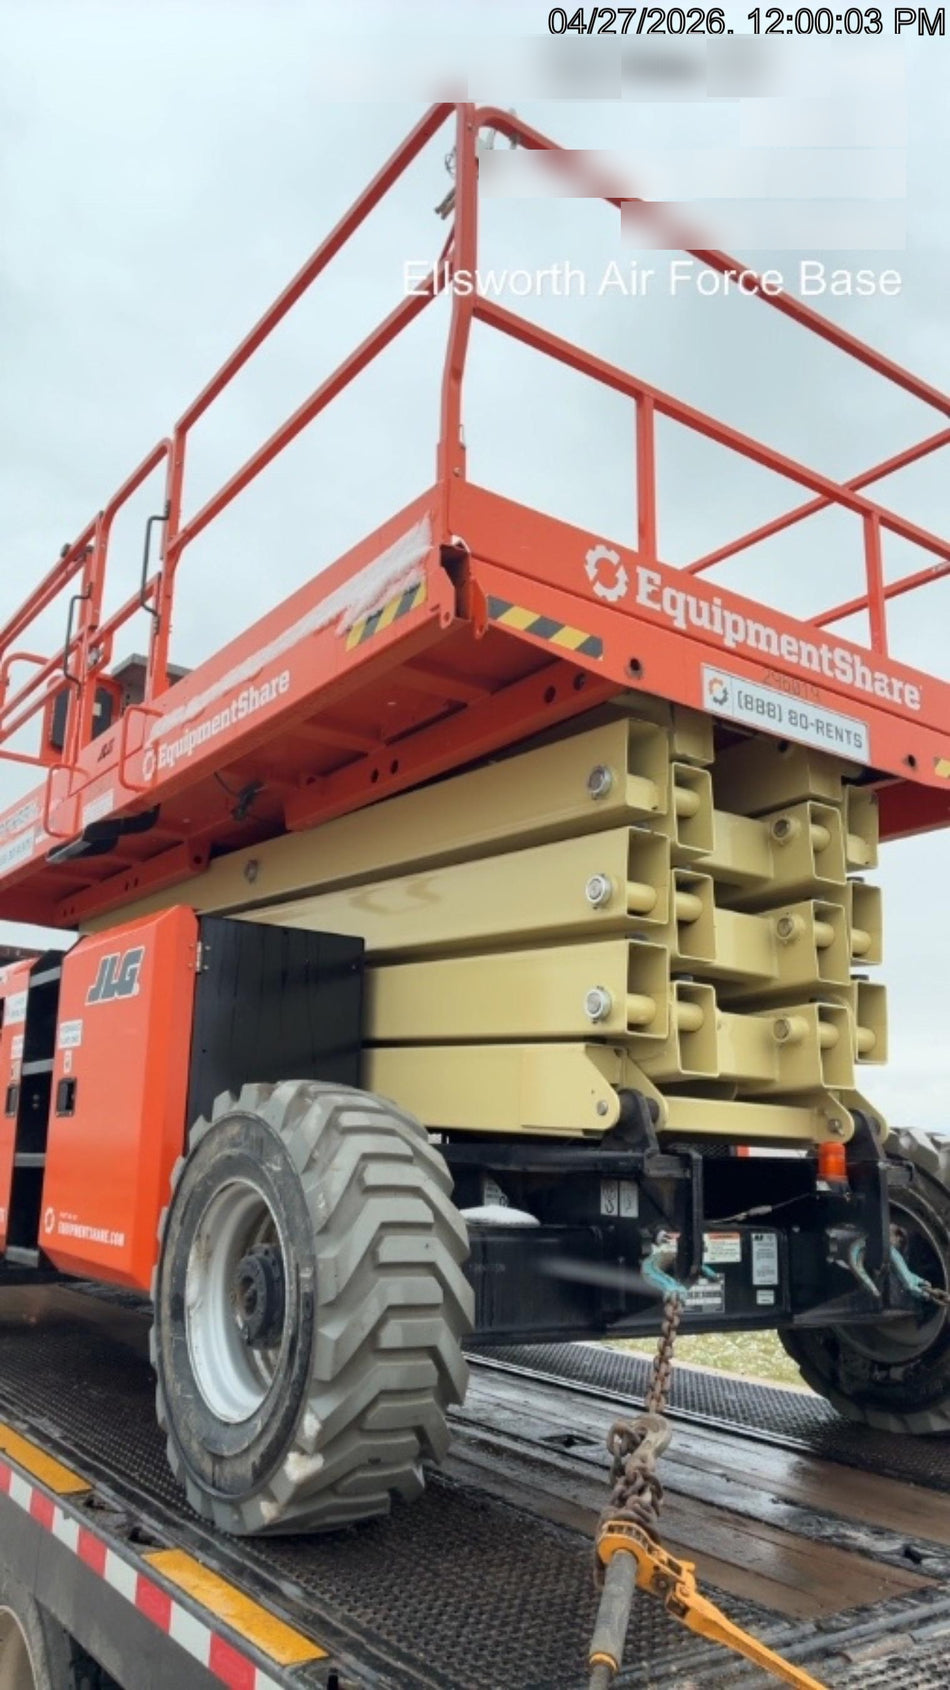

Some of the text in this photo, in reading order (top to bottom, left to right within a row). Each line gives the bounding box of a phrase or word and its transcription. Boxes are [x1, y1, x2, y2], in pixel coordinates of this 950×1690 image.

[634, 565, 921, 711] EquipmentShare
[157, 669, 291, 770] EquipmentShare
[737, 690, 863, 749] (888) 80-RENTS
[85, 946, 145, 1005] JLG
